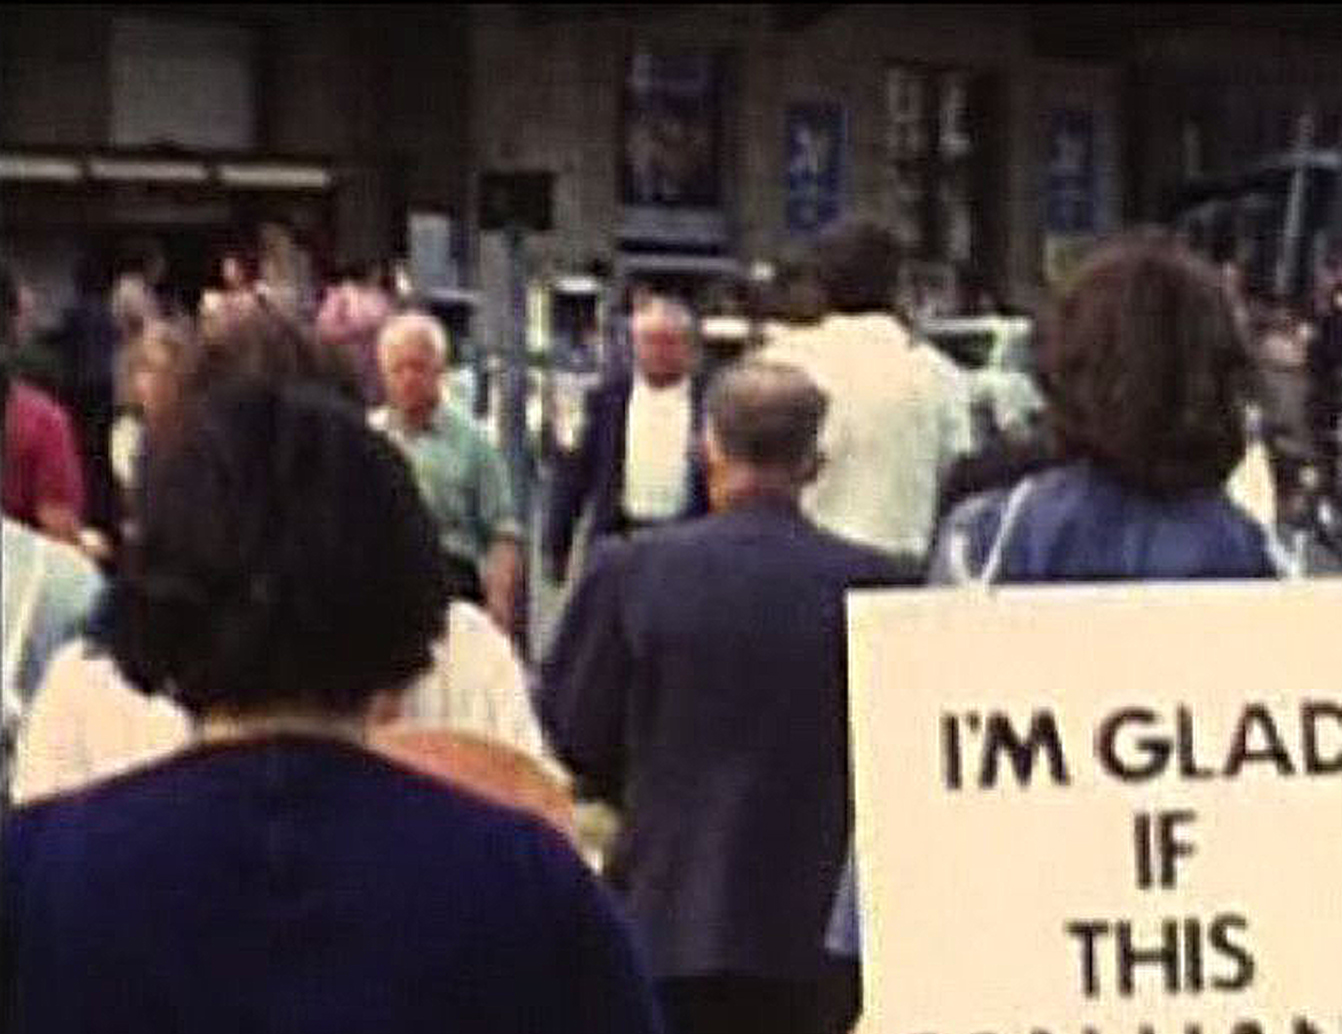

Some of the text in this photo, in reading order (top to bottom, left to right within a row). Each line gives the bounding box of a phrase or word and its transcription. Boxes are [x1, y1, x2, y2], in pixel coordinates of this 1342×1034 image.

[940, 710, 1071, 790] I'M
[1133, 810, 1196, 891] IF
[1066, 914, 1256, 999] THIS
